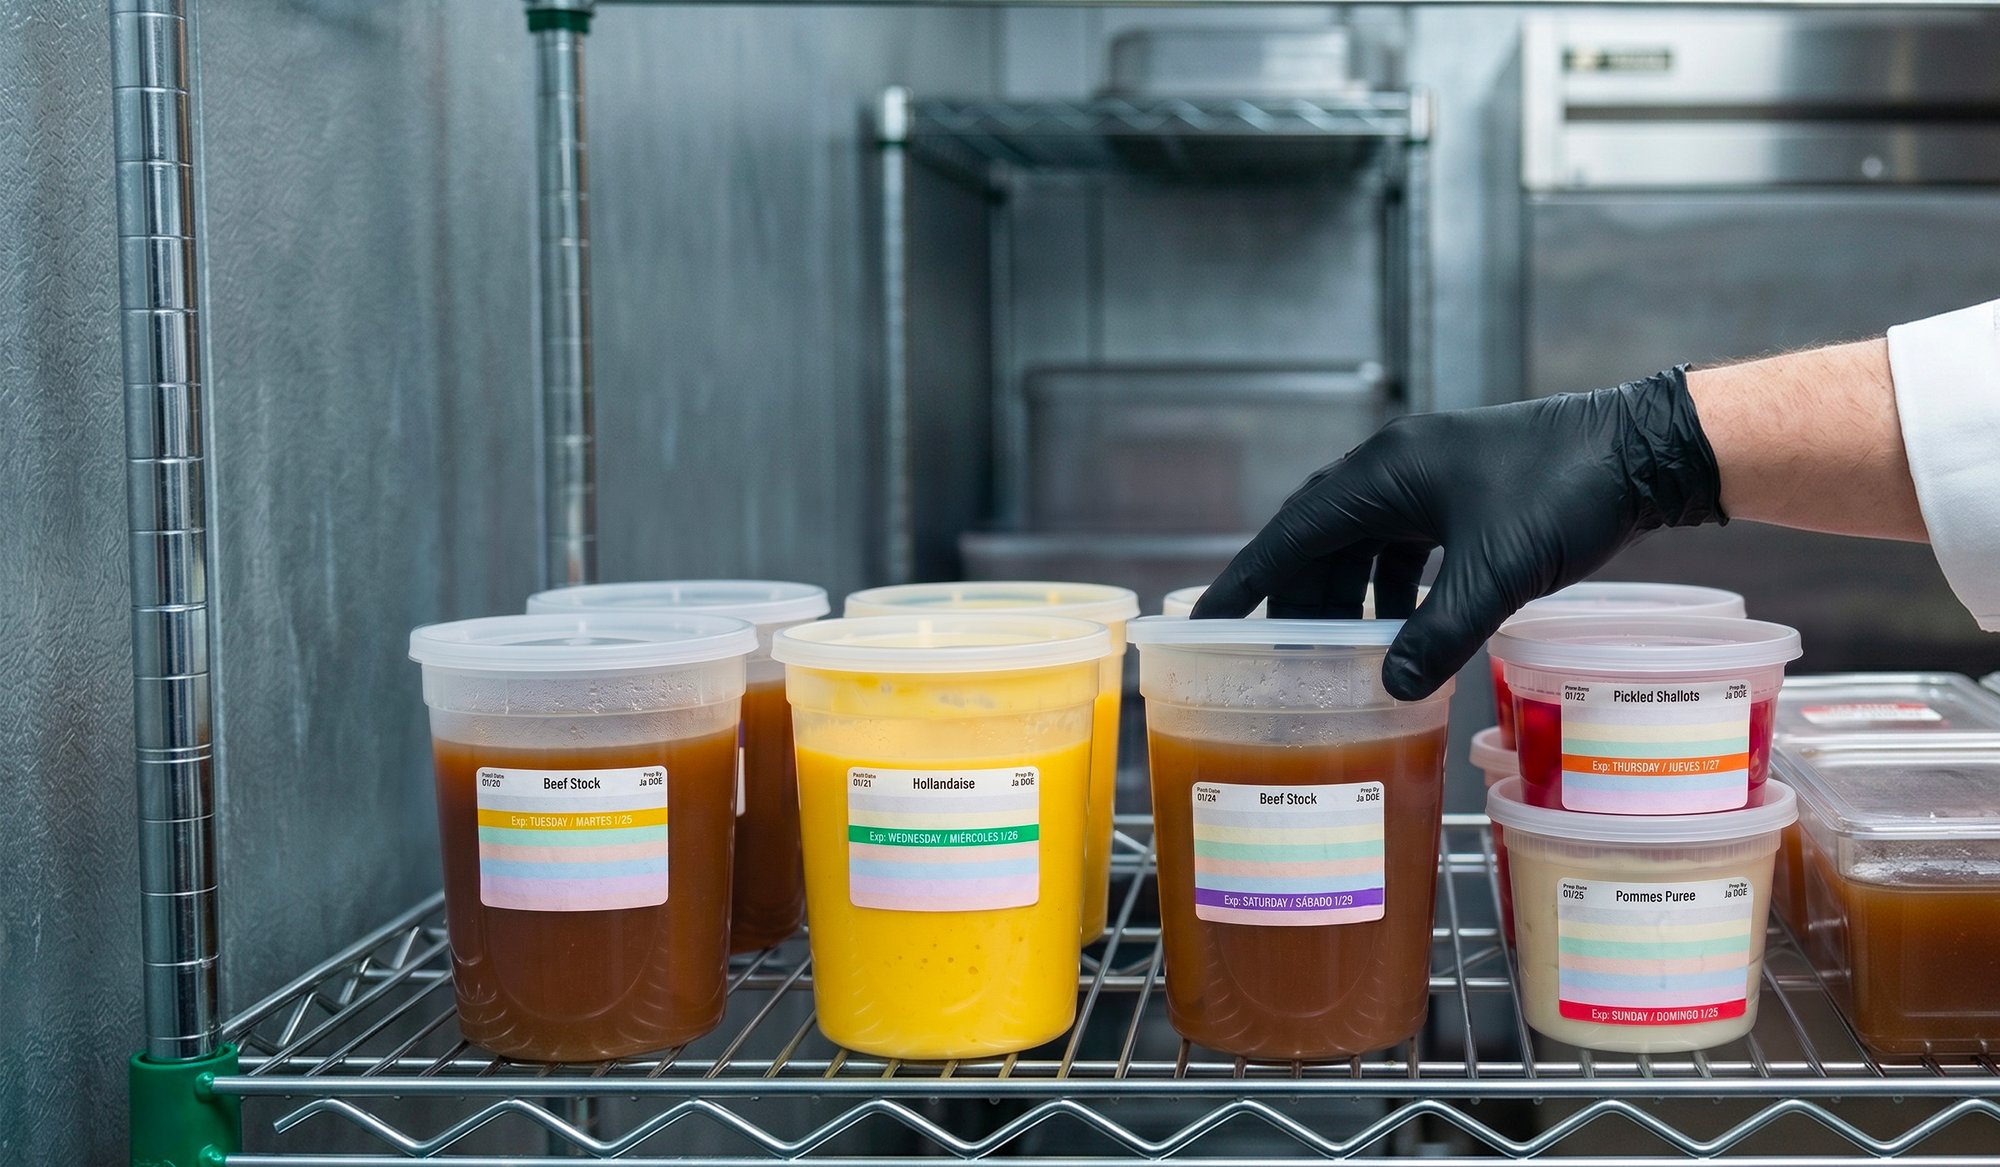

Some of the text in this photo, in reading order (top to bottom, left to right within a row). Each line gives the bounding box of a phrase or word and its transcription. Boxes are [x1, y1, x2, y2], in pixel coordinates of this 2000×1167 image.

[1565, 692, 1585, 701] 01/22
[1614, 690, 1700, 702] Pickled Shallots
[1734, 690, 1747, 698] DOE
[1592, 761, 1610, 772] Exp:
[1612, 762, 1660, 772] THURSDAY
[1668, 761, 1700, 772] JUEVES
[1702, 760, 1719, 770] 1/27
[482, 779, 500, 787] 01/20
[544, 778, 600, 789] Beef Stock
[649, 778, 662, 786] DOE
[853, 779, 871, 787] 01/21
[913, 778, 975, 790] Hollandaise
[1021, 778, 1034, 786] DOE
[1197, 794, 1216, 802] 01/24
[1260, 793, 1317, 805] Beef Stock
[1366, 793, 1379, 801] DOE
[512, 816, 528, 826] Exp:
[530, 817, 568, 826] TUESDAY
[576, 817, 612, 826] MARTES
[614, 815, 632, 825] 1/25
[870, 832, 886, 842] Exp:
[888, 833, 941, 843] WEDNESDAY
[950, 832, 999, 843] MIÉRCOLES
[1000, 831, 1018, 840] 1/26
[1563, 890, 1584, 899] 01/25
[1616, 891, 1696, 902] Pommes Puree
[1734, 889, 1747, 897] DOE
[1225, 895, 1241, 906] Exp:
[1243, 897, 1287, 907] SATURDAY
[1296, 896, 1332, 907] SÁBADO
[1335, 896, 1352, 905] 1/29
[1592, 1009, 1609, 1020] Exp:
[1612, 1011, 1648, 1021] SUNDAY
[1657, 1010, 1698, 1021] DOMINGO
[1701, 1009, 1718, 1019] 1/25
